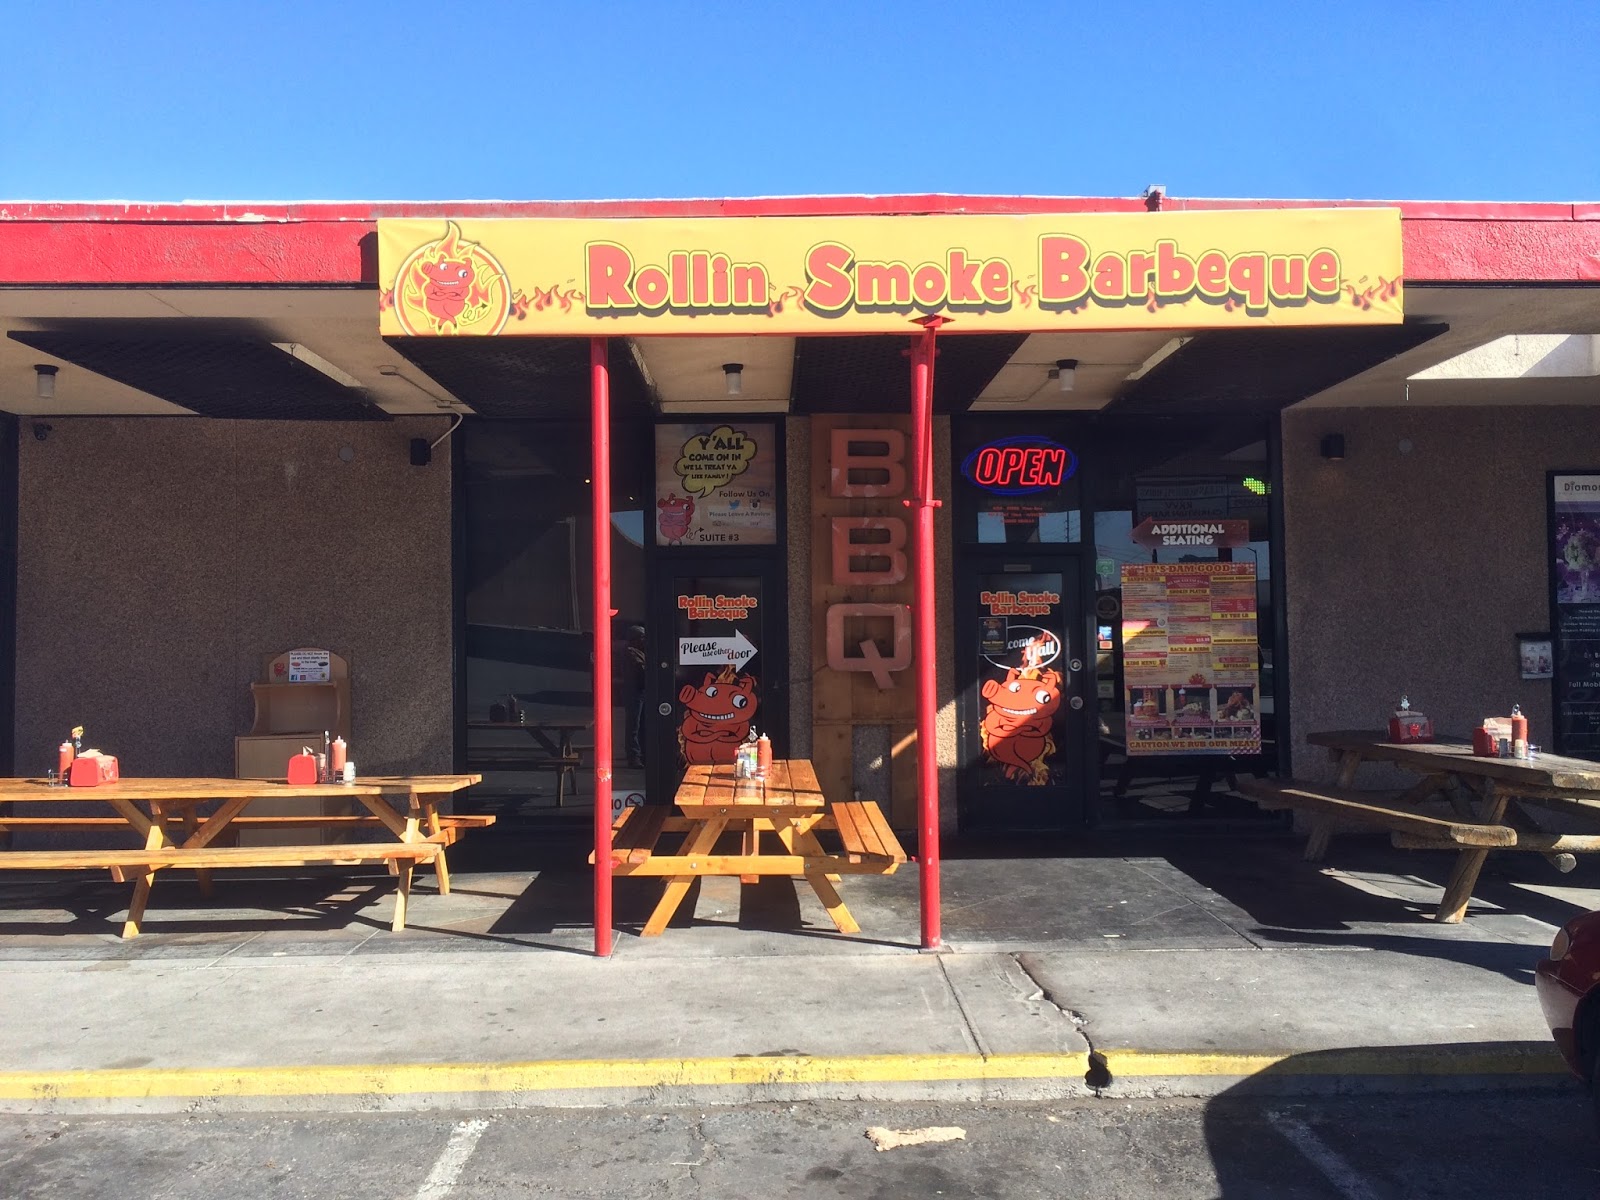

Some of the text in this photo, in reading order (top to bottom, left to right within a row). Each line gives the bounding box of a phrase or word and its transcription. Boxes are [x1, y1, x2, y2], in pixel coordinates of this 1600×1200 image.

[586, 233, 1340, 315] Rollin Smoke Barbeque
[698, 435, 744, 450] Y'ALL
[689, 453, 741, 461] COME ON IN
[704, 463, 726, 471] TREAT
[726, 463, 737, 471] YA
[976, 448, 1066, 486] OPEN
[719, 490, 771, 498] Follow Us On
[1151, 524, 1225, 535] ADDITIONAL
[699, 533, 740, 542] SUITE #3
[1162, 534, 1214, 546] SEATING
[1197, 564, 1231, 573] GOOD
[678, 595, 757, 609] Rollin Smoke
[981, 591, 1060, 605] Rollin Smoke
[688, 607, 748, 621] Barbeque
[990, 603, 1050, 617] Barbeque
[680, 641, 717, 654] Please
[714, 648, 730, 656] other
[727, 649, 751, 660] door
[1208, 740, 1228, 748] OUR
